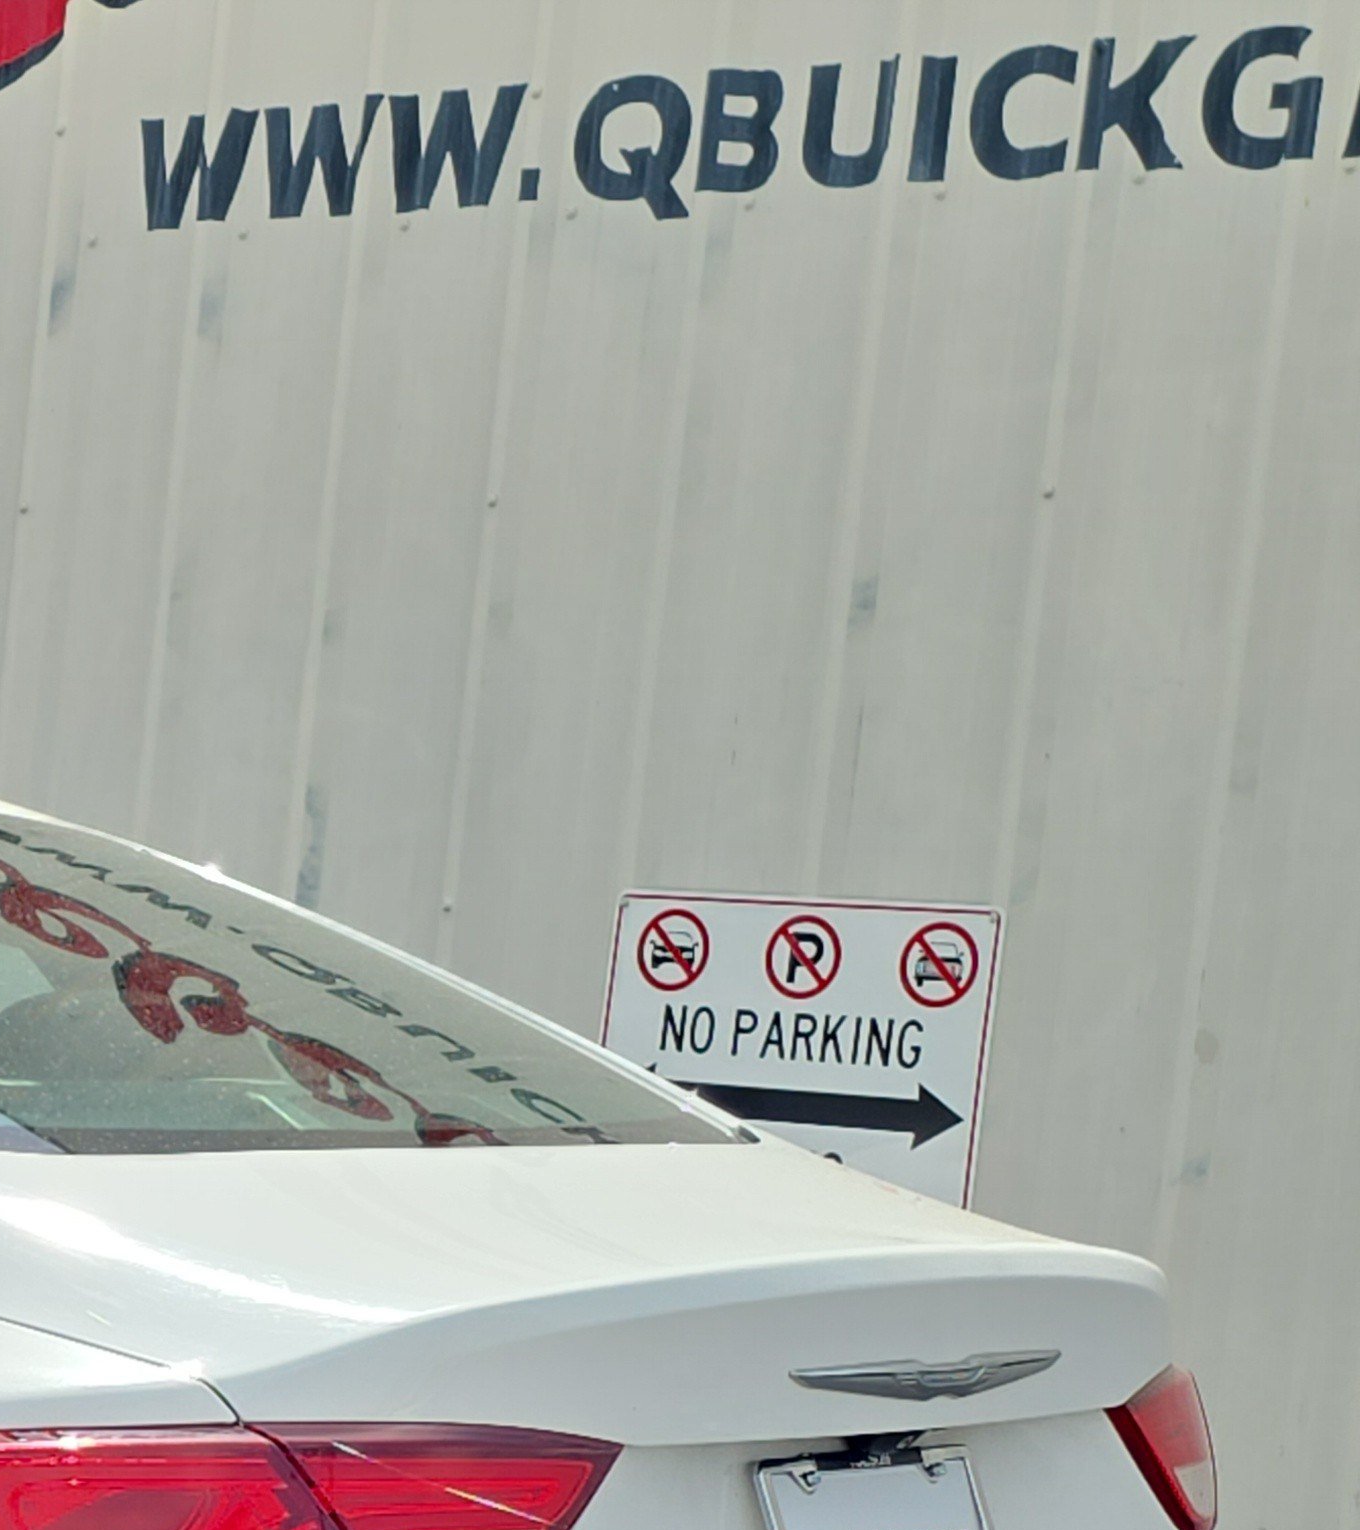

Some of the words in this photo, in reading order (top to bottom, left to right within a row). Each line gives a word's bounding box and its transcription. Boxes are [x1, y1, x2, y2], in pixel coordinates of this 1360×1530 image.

[140, 26, 1360, 231] WWW.QBUICKG
[659, 1004, 716, 1054] NO
[730, 1008, 925, 1070] PARKING
